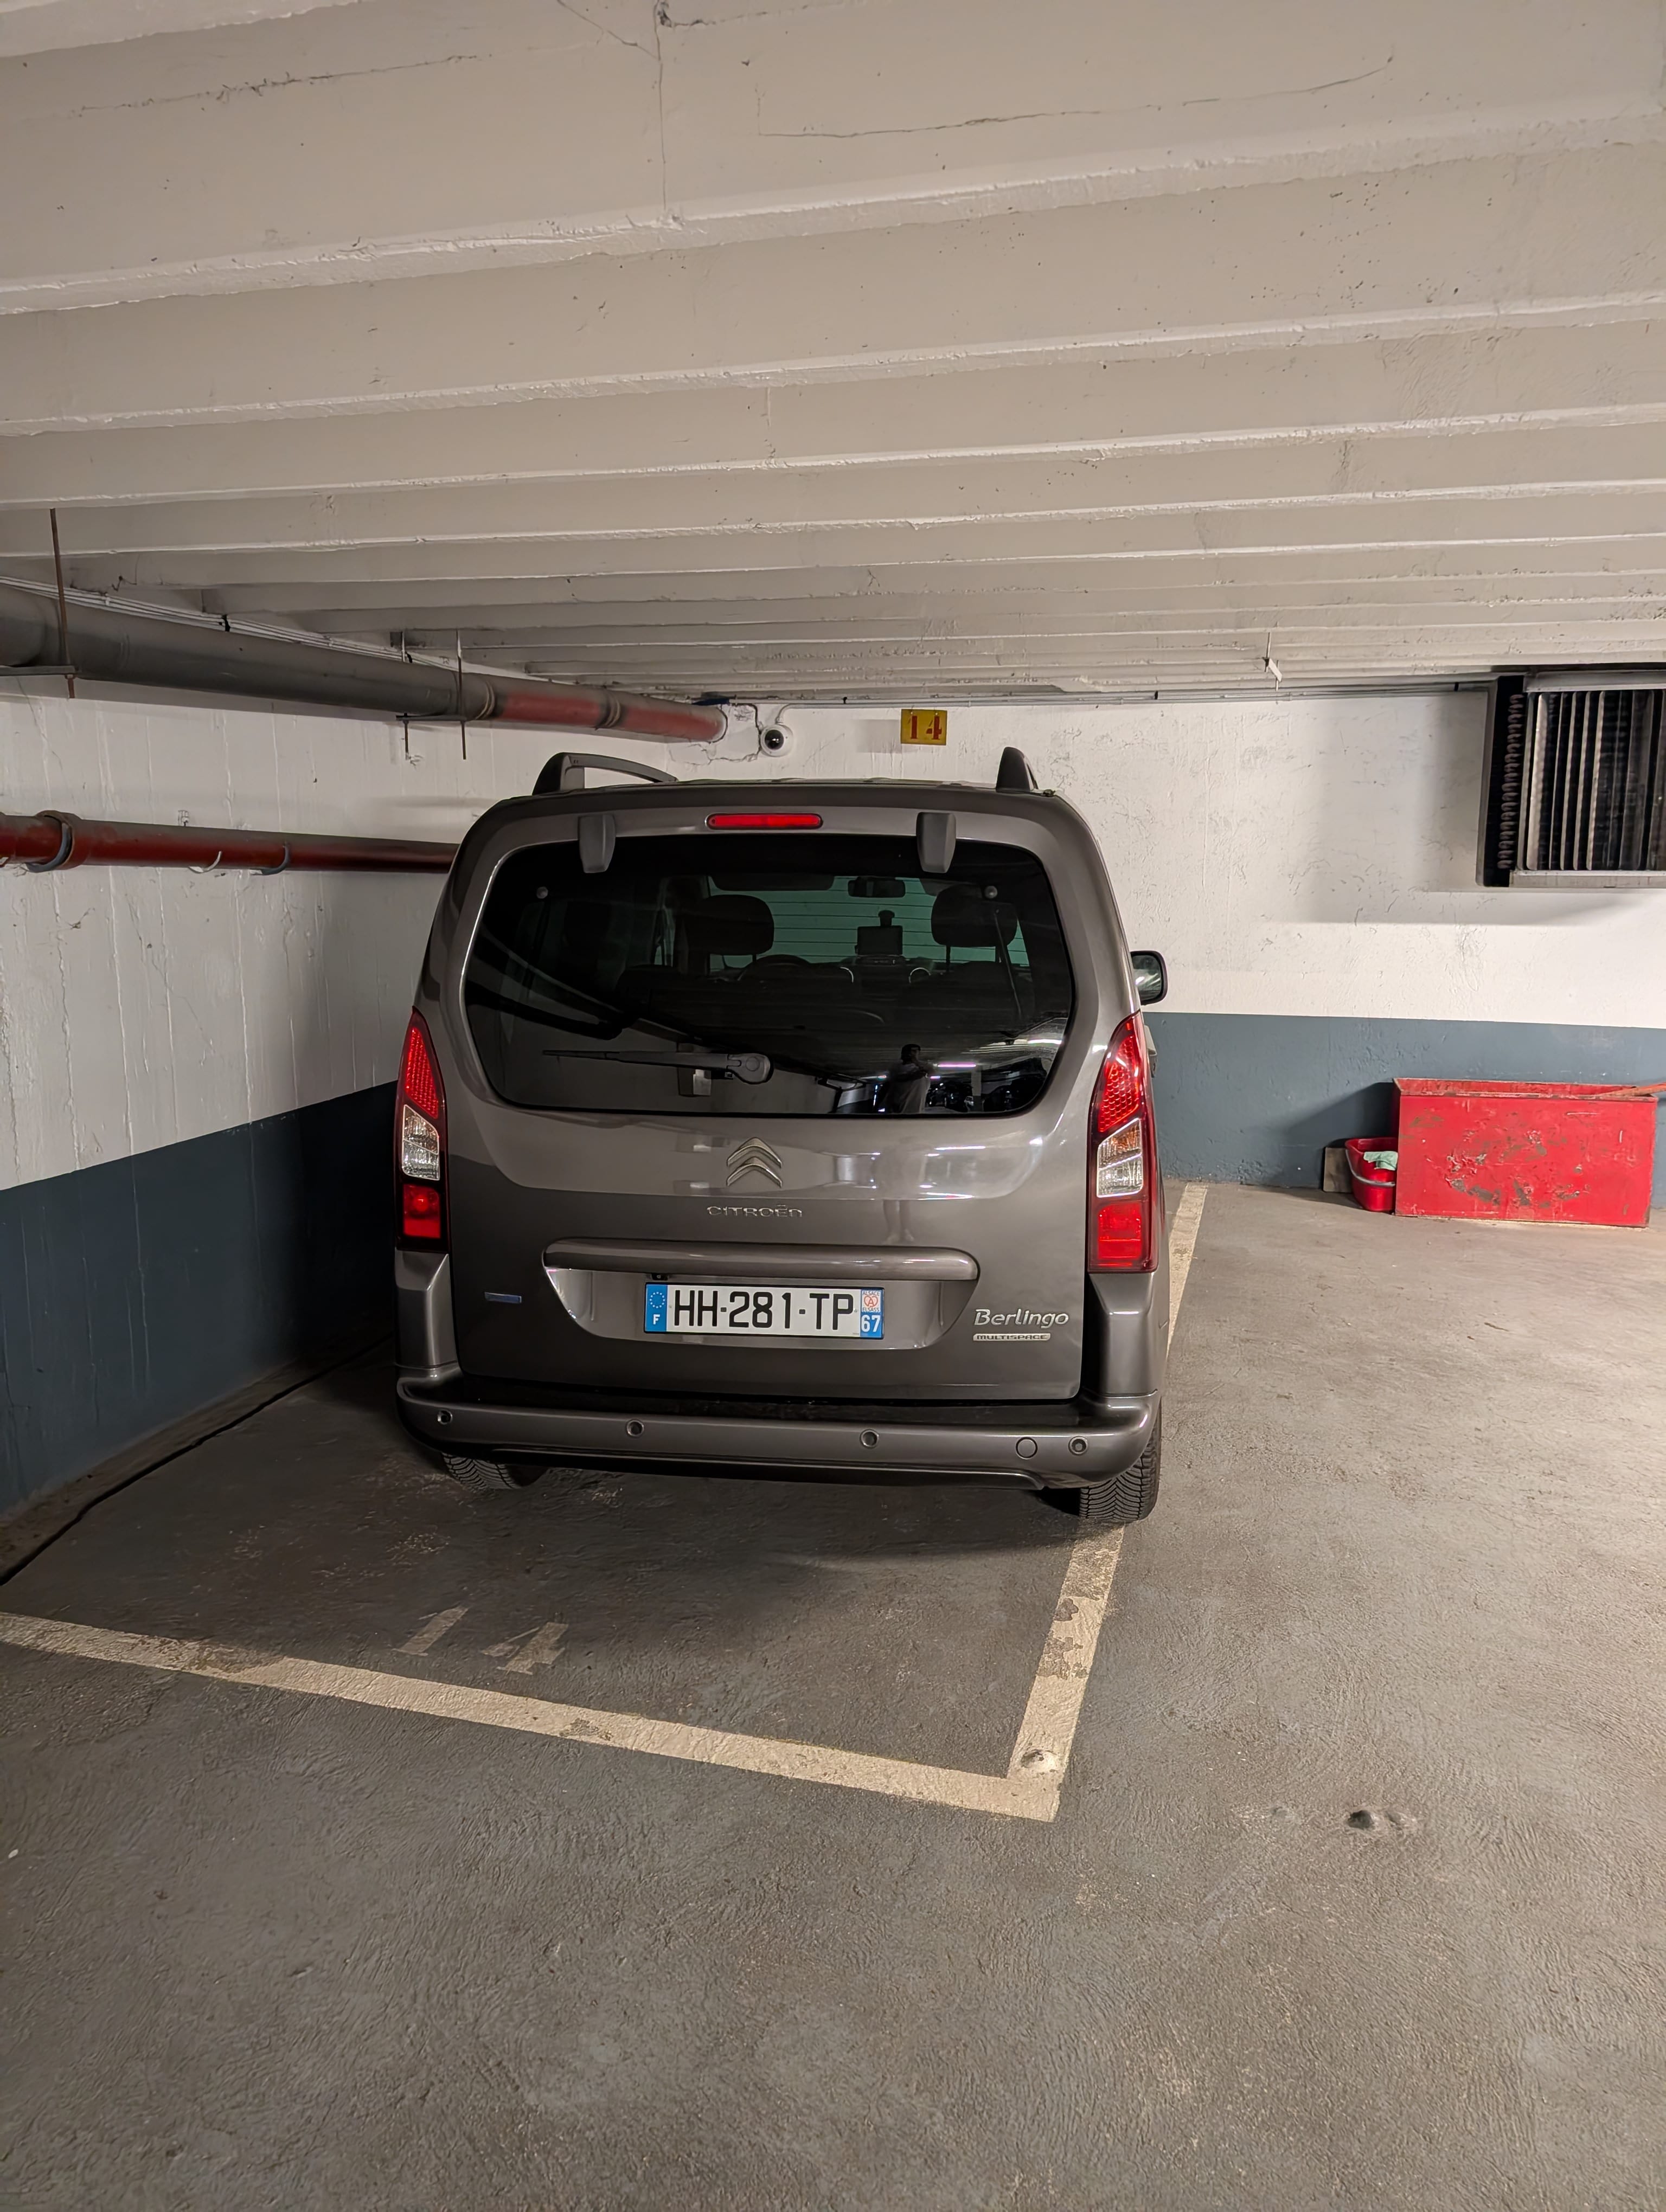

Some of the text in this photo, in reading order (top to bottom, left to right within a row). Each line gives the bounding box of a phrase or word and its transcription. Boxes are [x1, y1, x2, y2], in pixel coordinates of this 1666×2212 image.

[908, 715, 943, 740] 14
[652, 1314, 661, 1325] F
[674, 1289, 855, 1331] HH-281-TP
[974, 1308, 1069, 1329] Berlingo
[861, 1314, 881, 1333] 67
[392, 1600, 569, 1676] 14
